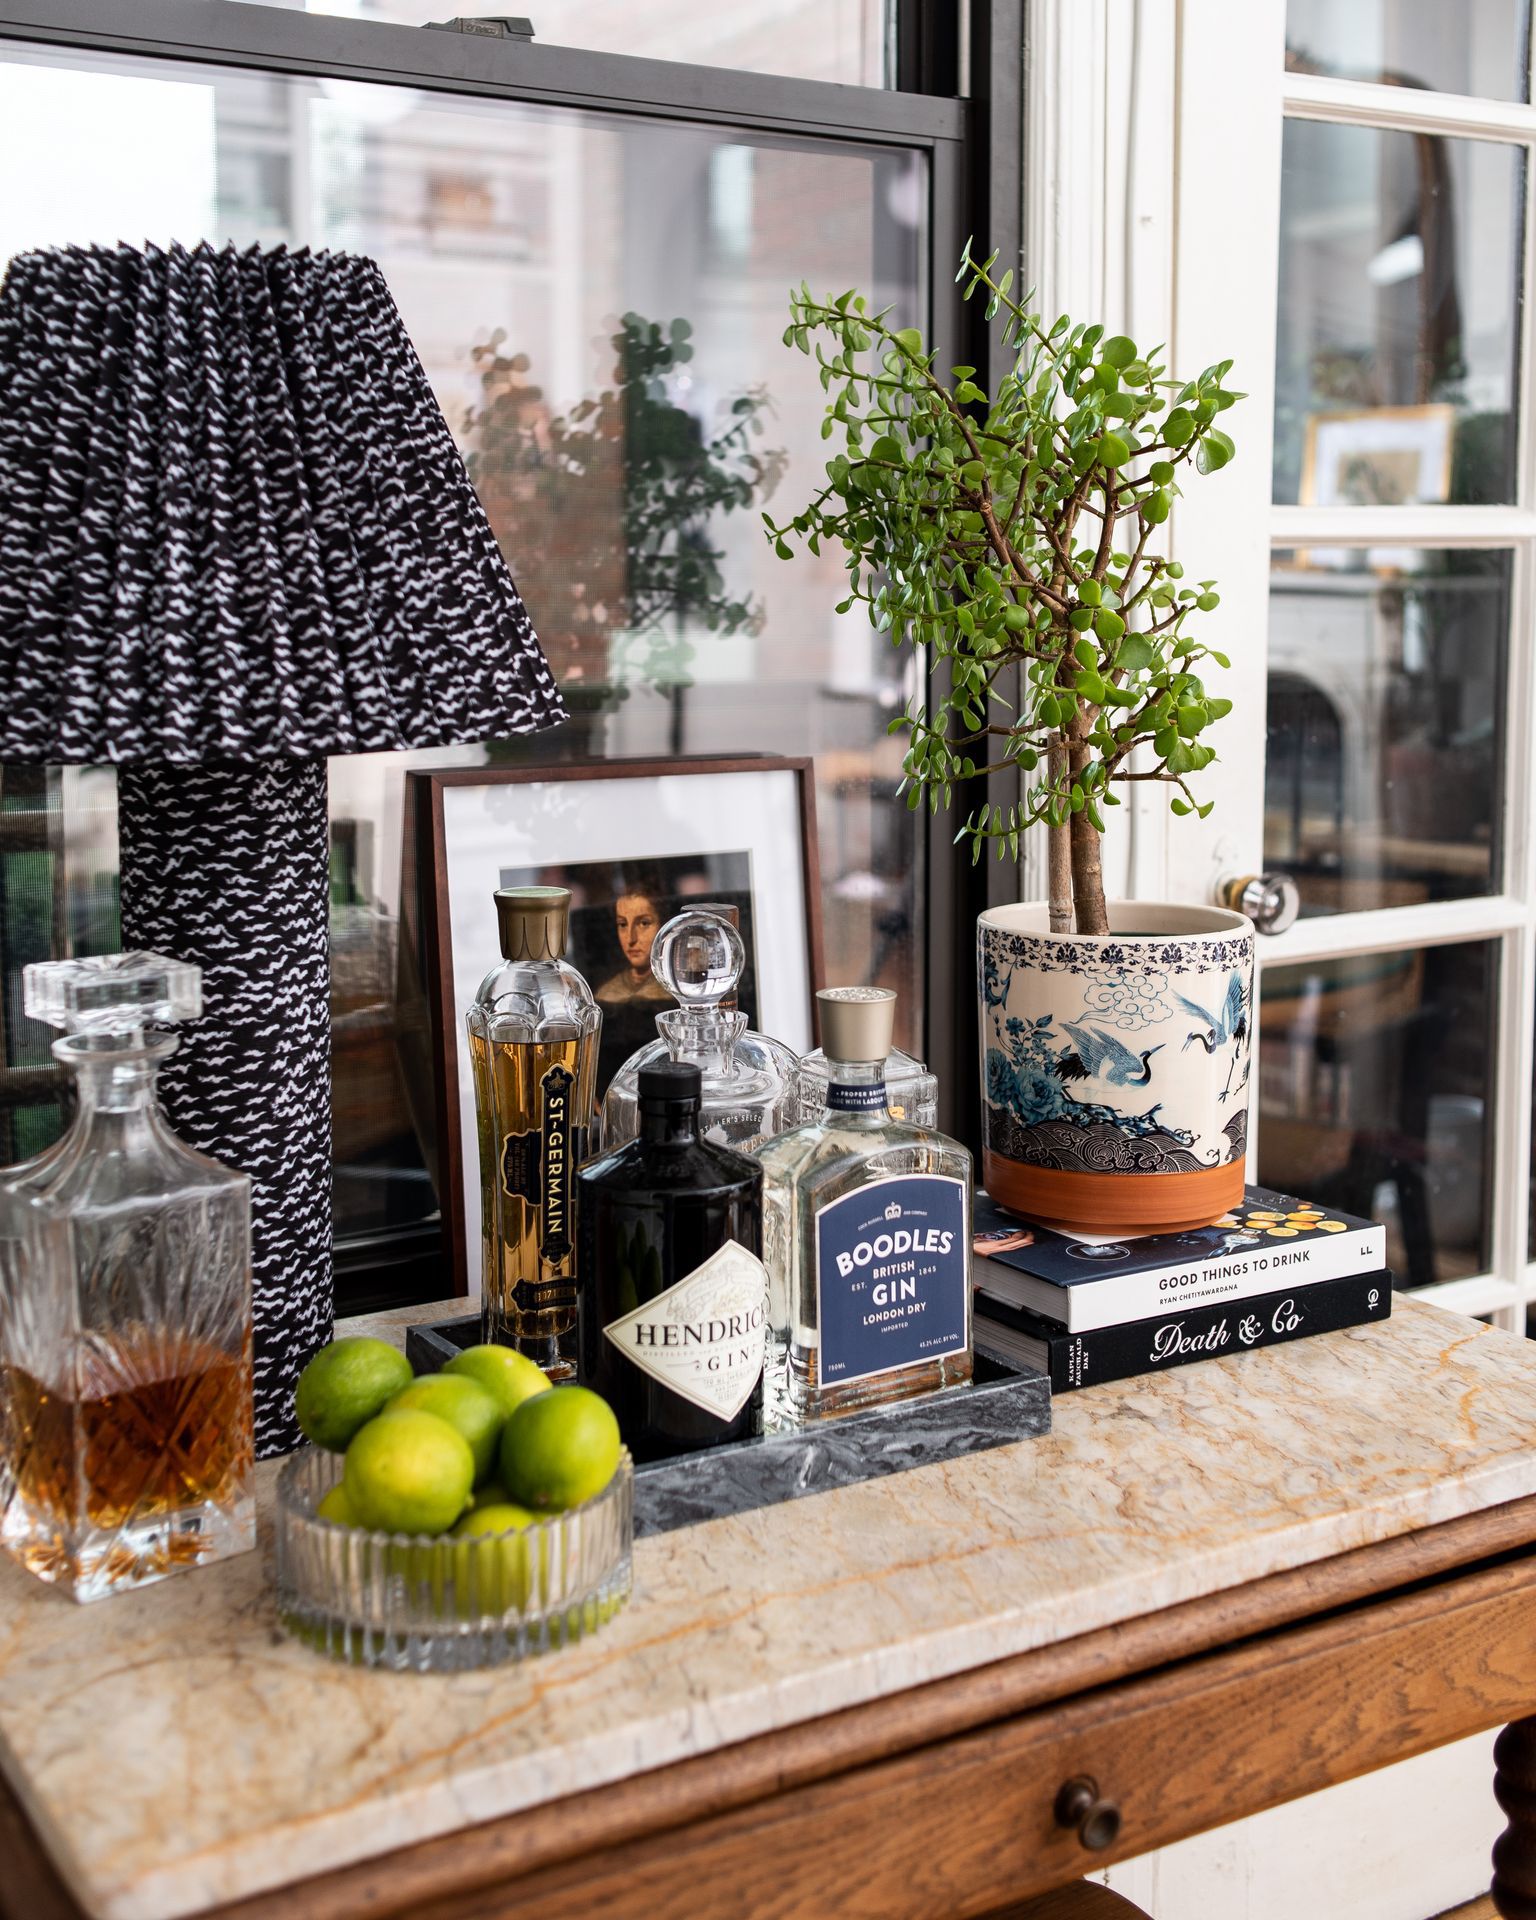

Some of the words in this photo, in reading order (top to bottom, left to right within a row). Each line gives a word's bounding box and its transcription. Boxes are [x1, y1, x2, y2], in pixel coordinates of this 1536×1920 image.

[835, 1228, 954, 1277] BOODLES
[1360, 1246, 1373, 1256] LL
[873, 1259, 915, 1279] BRITISH
[1159, 1272, 1198, 1290] GOOD
[1202, 1262, 1249, 1282] THINGS
[1252, 1259, 1268, 1271] TO
[1273, 1250, 1310, 1268] DRINK
[851, 1282, 867, 1291] EST.
[872, 1276, 916, 1305] GIN
[1160, 1297, 1178, 1305] RYAN
[1180, 1283, 1238, 1301] CHETIYAWARDANA
[863, 1306, 905, 1326] LONDON
[907, 1302, 927, 1315] DRY
[881, 1321, 909, 1333] IMPORTED
[1150, 1318, 1231, 1362] Death
[1238, 1314, 1265, 1345] &
[1271, 1299, 1304, 1334] Co
[708, 1348, 749, 1371] GIN
